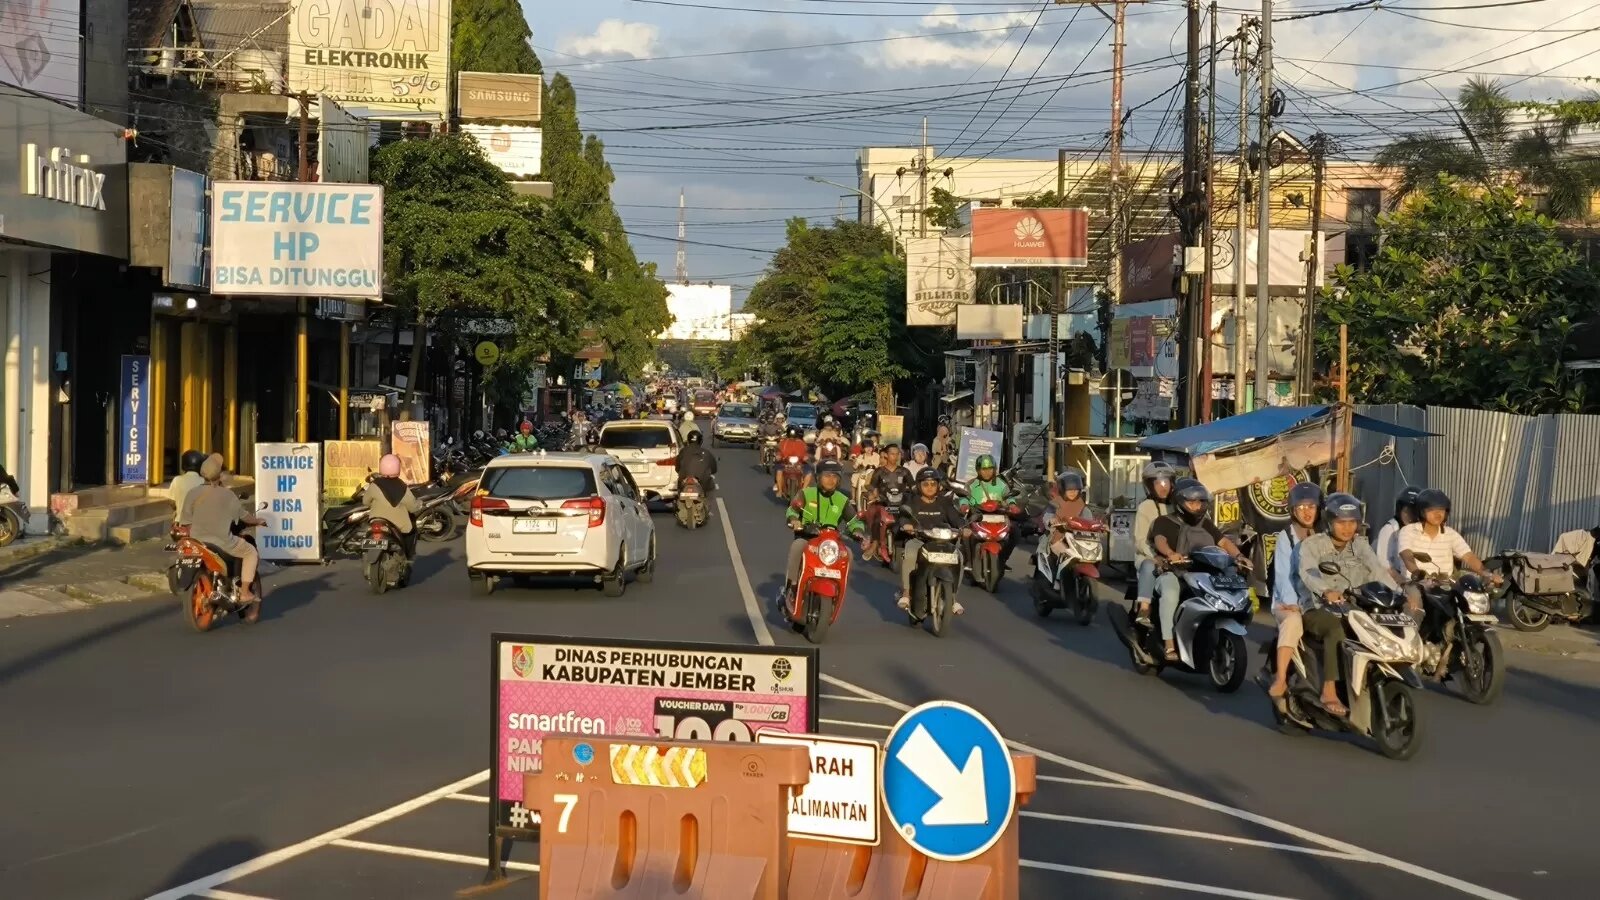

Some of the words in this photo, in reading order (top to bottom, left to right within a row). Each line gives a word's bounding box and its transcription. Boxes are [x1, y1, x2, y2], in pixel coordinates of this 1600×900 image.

[297, 0, 440, 51] GADAI
[304, 50, 429, 70] ELEKTRONIK
[390, 71, 440, 97] 5%
[389, 97, 436, 105] ADMIN
[469, 90, 530, 103] SAMSUNG
[21, 143, 106, 211] Infinix
[220, 190, 374, 225] SERVICE
[273, 231, 320, 261] HP
[216, 266, 263, 285] BISA
[269, 267, 377, 288] DITUNGGU
[946, 267, 955, 280] 9
[915, 290, 969, 301] BILLIARD
[130, 360, 140, 453] SERVICE
[126, 453, 141, 466] HP
[261, 455, 314, 469] SERVICE
[277, 474, 297, 492] HP
[272, 498, 302, 512] BISA
[281, 518, 293, 530] DI
[263, 535, 313, 548] TUNGGU
[555, 648, 607, 665] DINAS
[610, 651, 743, 671] PERHUBUNGAN
[542, 664, 665, 687] KABUPATEN
[669, 671, 756, 692] JEMBER
[659, 700, 701, 710] VOUCHER
[702, 702, 726, 712] DATA
[508, 711, 606, 735] smartfren
[553, 793, 579, 833] 7
[788, 796, 867, 822] ALIMANTAN
